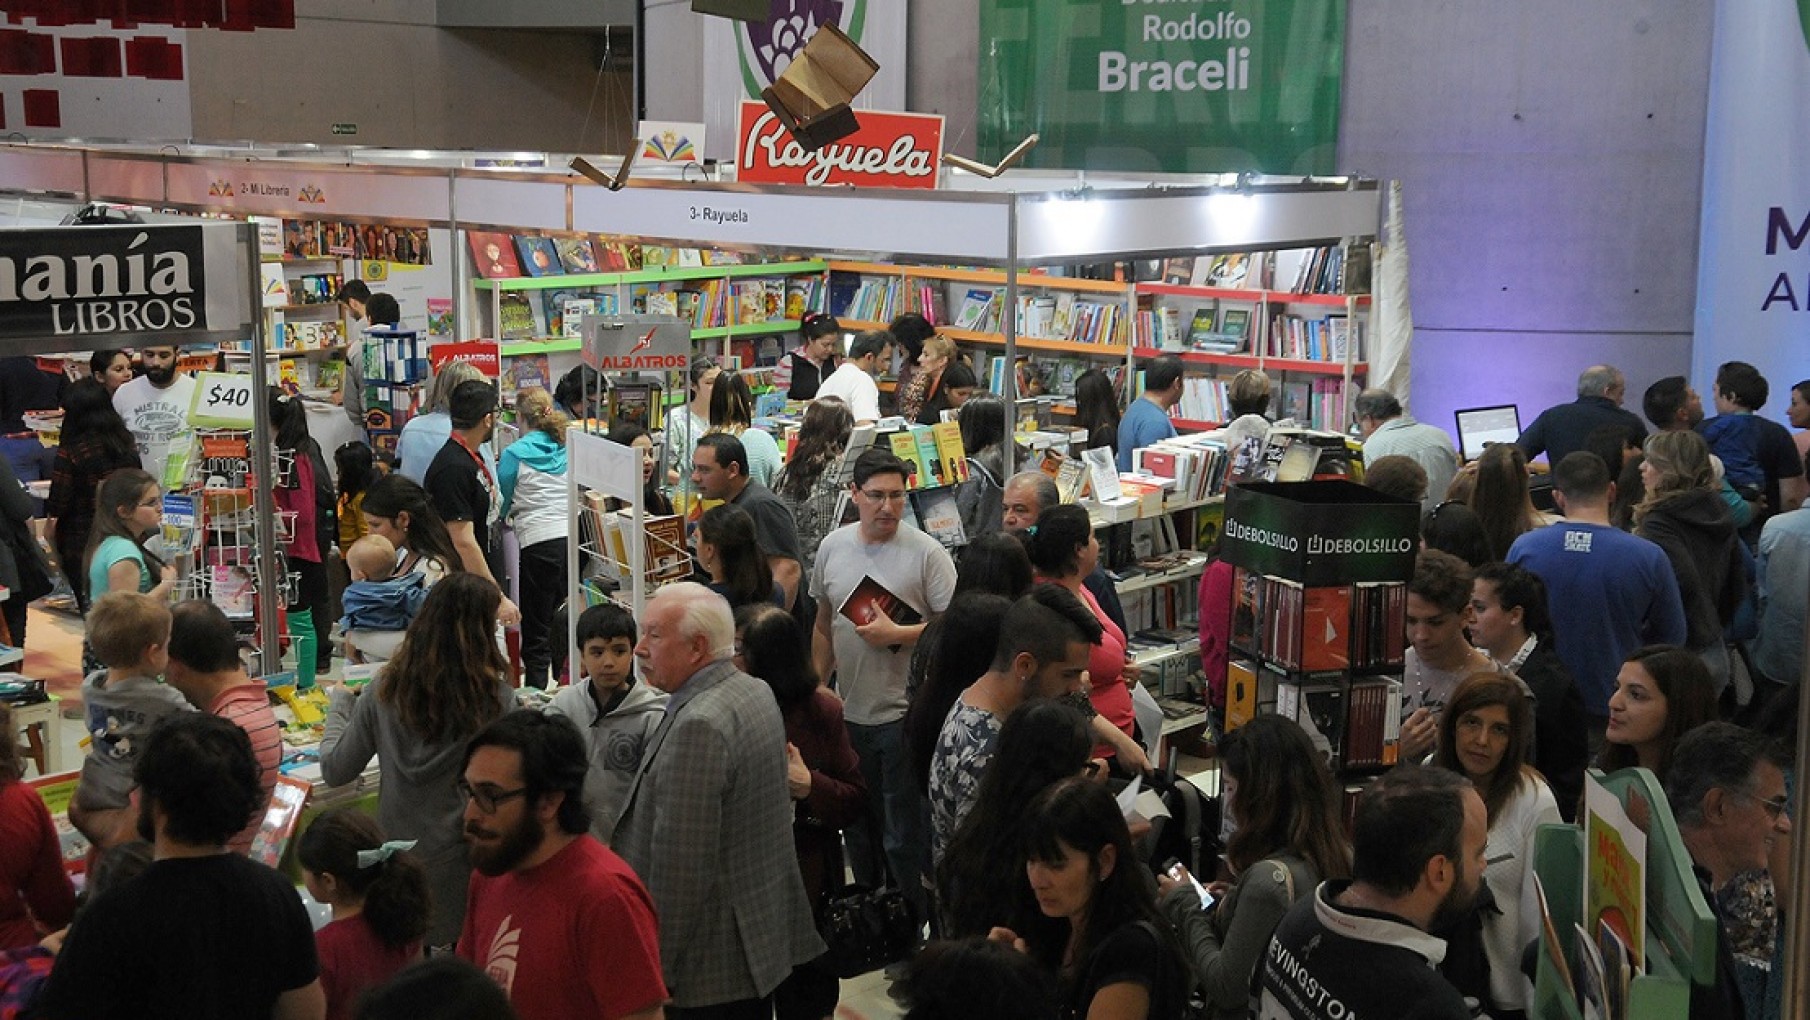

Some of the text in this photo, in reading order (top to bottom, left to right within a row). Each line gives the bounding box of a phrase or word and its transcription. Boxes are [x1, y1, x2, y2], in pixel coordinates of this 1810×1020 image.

[1143, 11, 1250, 41] Rodolfo
[1099, 47, 1250, 91] Braceli
[744, 110, 932, 186] Rayuela
[690, 206, 748, 225] 3- Rayuela
[1761, 272, 1810, 311] A
[51, 298, 195, 335] LIBROS
[453, 353, 497, 363] ALBATROS
[601, 354, 687, 369] ALBATROS
[207, 384, 250, 407] $40
